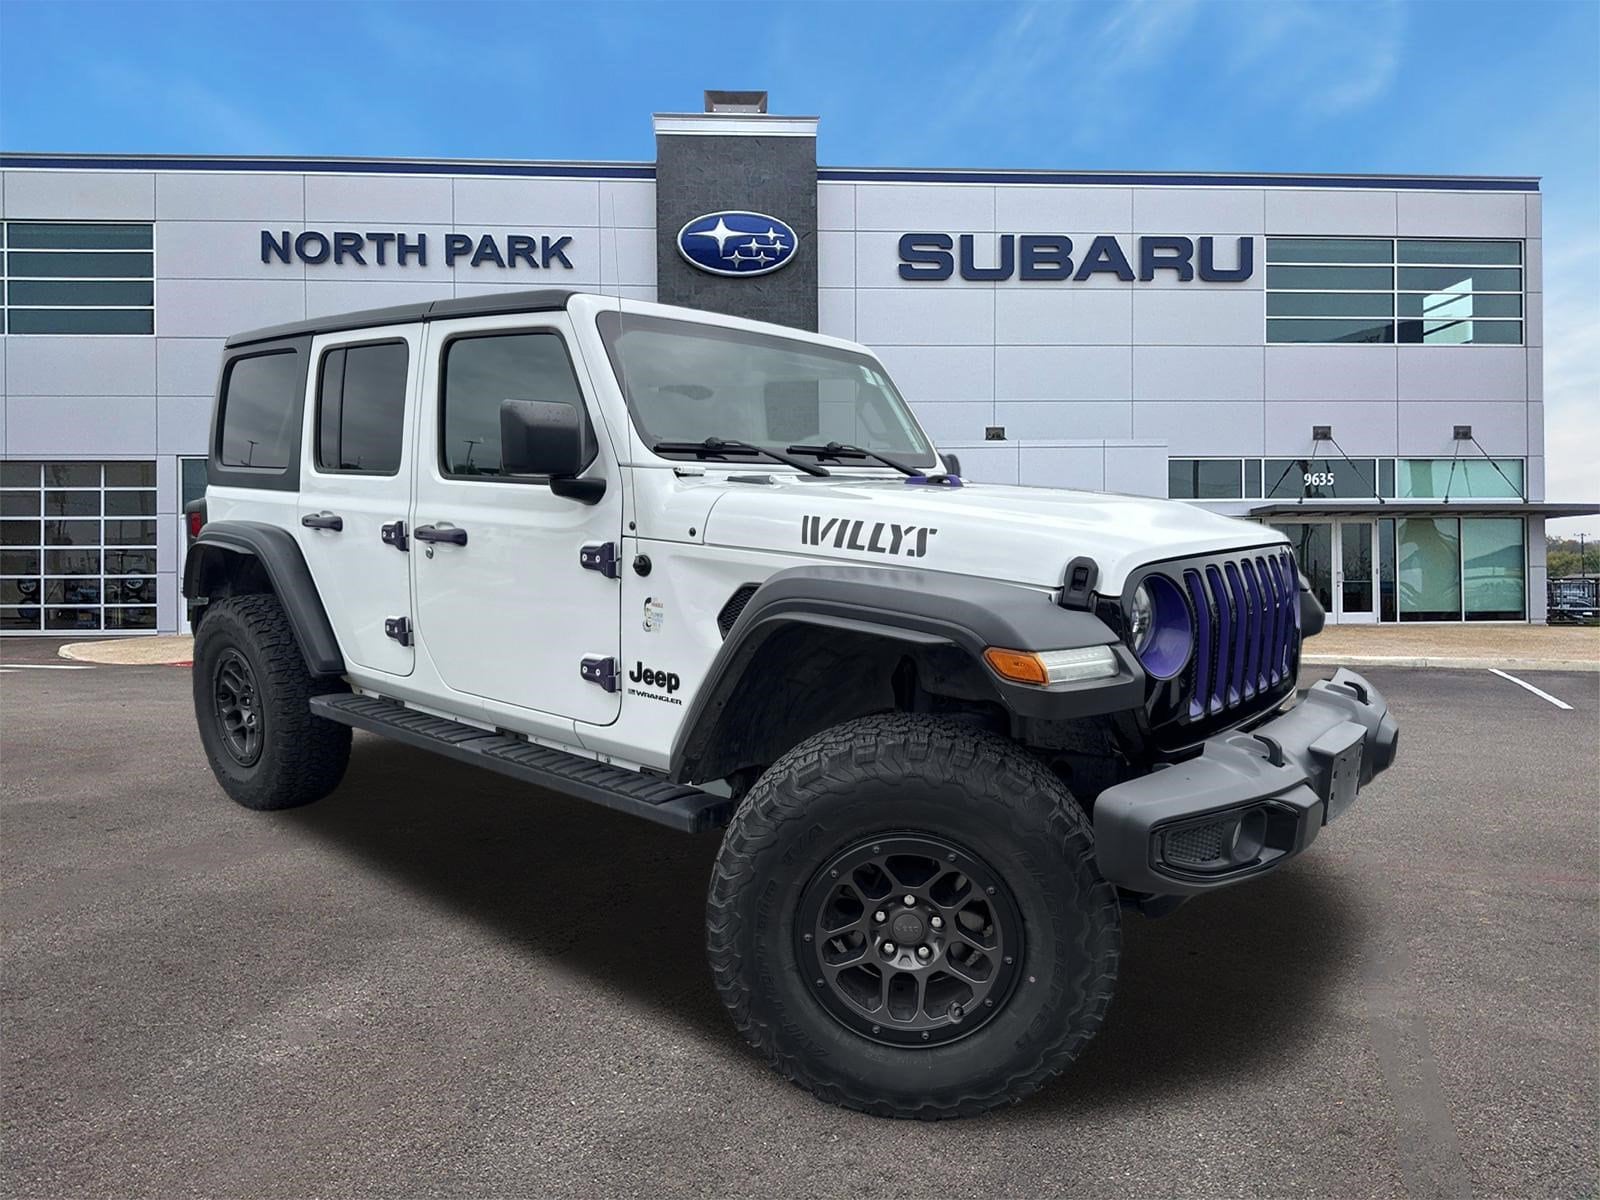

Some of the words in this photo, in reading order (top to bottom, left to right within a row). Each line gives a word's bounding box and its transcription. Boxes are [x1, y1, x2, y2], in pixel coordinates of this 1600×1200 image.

[260, 230, 428, 267] NORTH
[444, 233, 574, 269] PARK
[898, 233, 1254, 283] SUBARU
[1303, 472, 1335, 487] 9635
[801, 515, 938, 558] WILLYS
[629, 660, 680, 694] Jeep
[636, 689, 682, 705] WRANGLER
